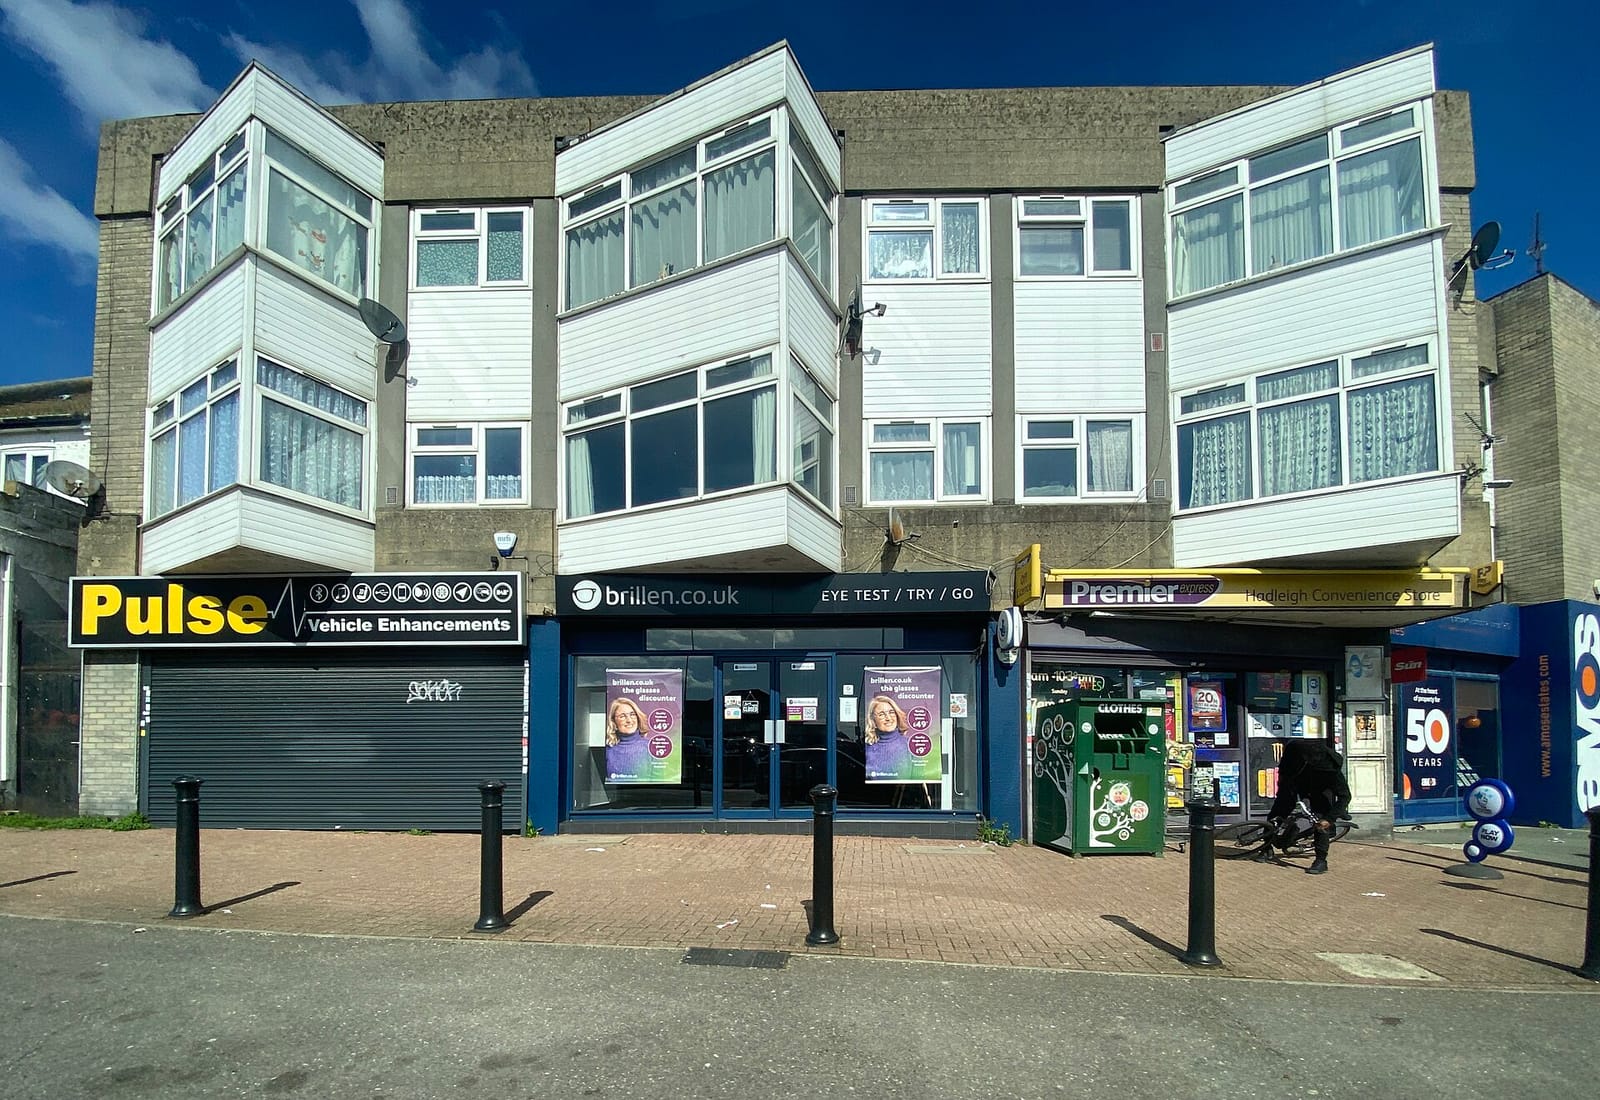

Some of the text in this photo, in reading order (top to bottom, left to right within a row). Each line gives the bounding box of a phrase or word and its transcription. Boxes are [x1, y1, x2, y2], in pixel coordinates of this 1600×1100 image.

[606, 585, 740, 605] brillen.co.uk
[821, 590, 849, 601] EYE
[854, 589, 890, 601] TEST
[907, 588, 935, 600] TRY
[951, 587, 974, 600] GO
[1071, 580, 1215, 604] Premier express
[1245, 588, 1441, 605] Hadleigh Convenience Store
[81, 584, 268, 635] Pulse
[308, 617, 511, 633] Vehicle Enhancements
[635, 687, 660, 695] glasses
[894, 685, 919, 693] glasses
[897, 692, 934, 700] discounter
[1098, 703, 1142, 714] CLOTHES
[1406, 708, 1450, 754] 50
[1412, 758, 1442, 767] YEARS
[1480, 834, 1498, 842] NOW
[1481, 828, 1500, 836] PLAY
